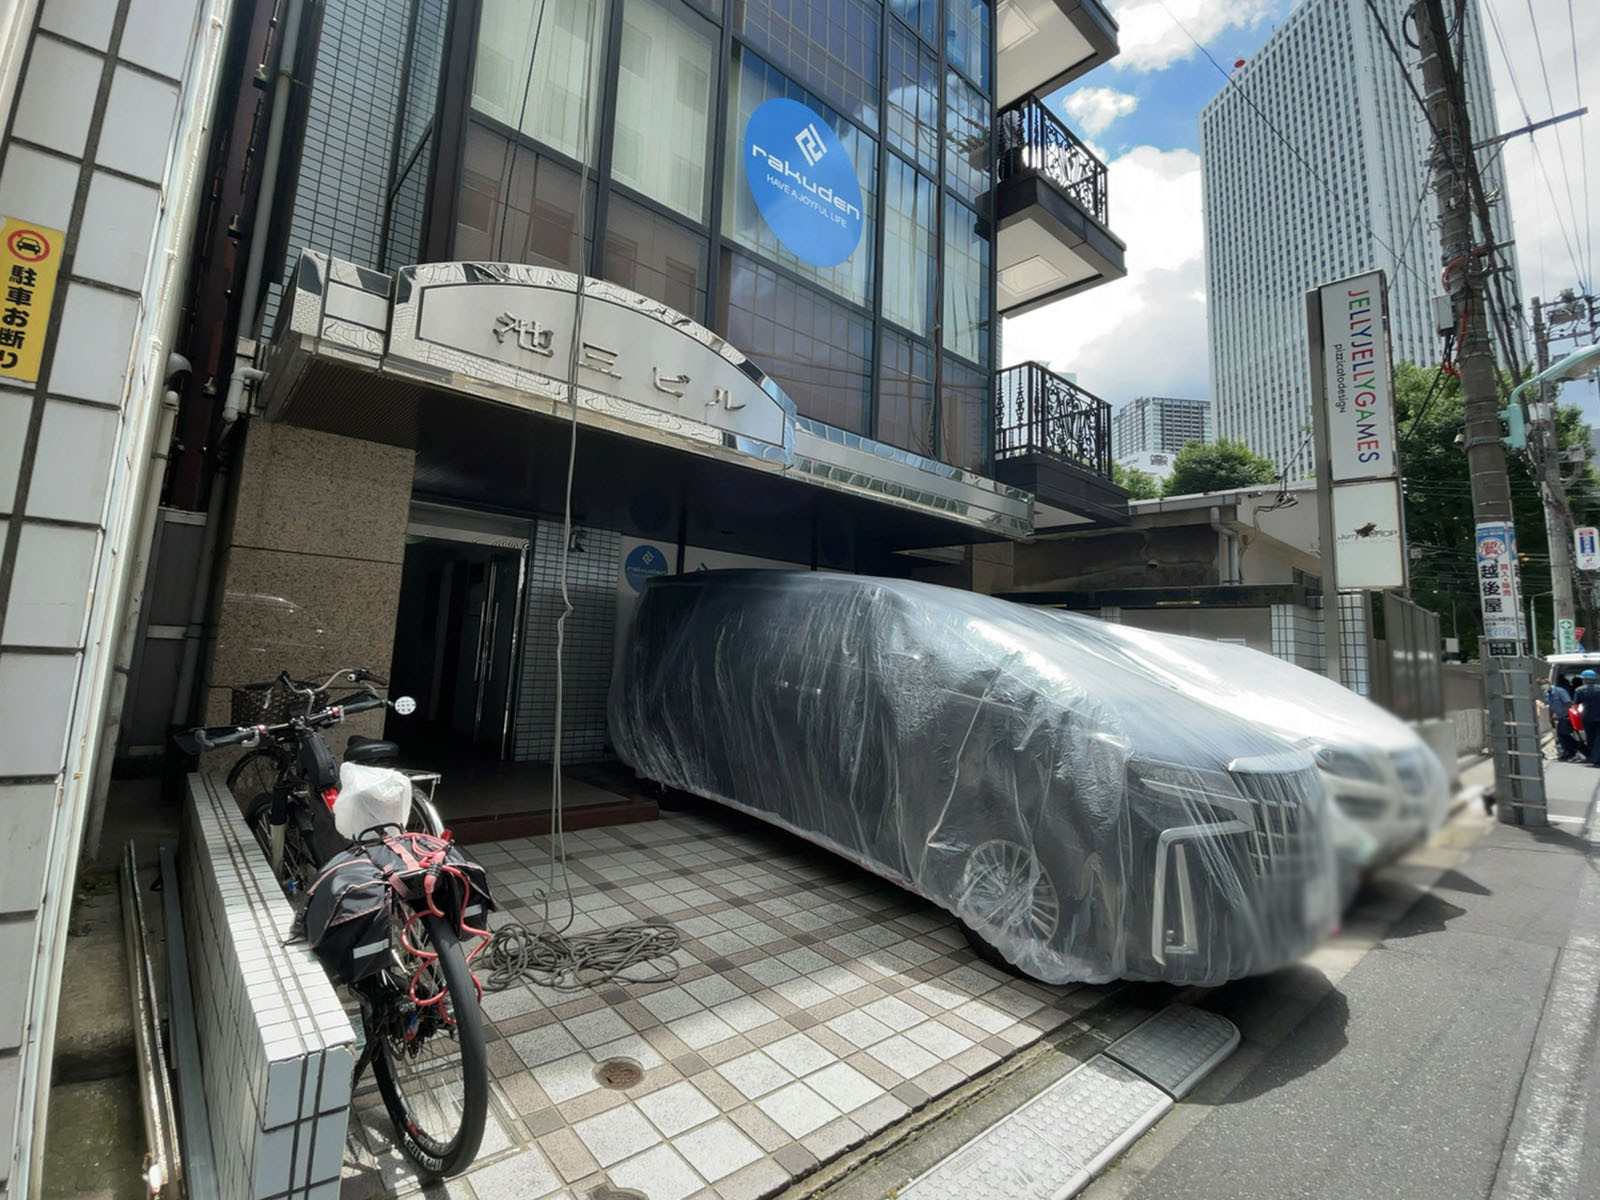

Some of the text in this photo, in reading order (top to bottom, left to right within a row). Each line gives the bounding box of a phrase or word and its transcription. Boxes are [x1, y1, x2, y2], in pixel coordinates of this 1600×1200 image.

[752, 144, 860, 221] rakuden
[766, 173, 791, 195] HAVE
[798, 194, 830, 218] JOYFUL
[830, 212, 849, 228] LIFE
[0, 264, 38, 369] 駐車お断り
[493, 311, 747, 411] 池三ビル
[1347, 289, 1380, 464] JELLYJELLYGAMES
[1480, 559, 1503, 613] 越後屋
